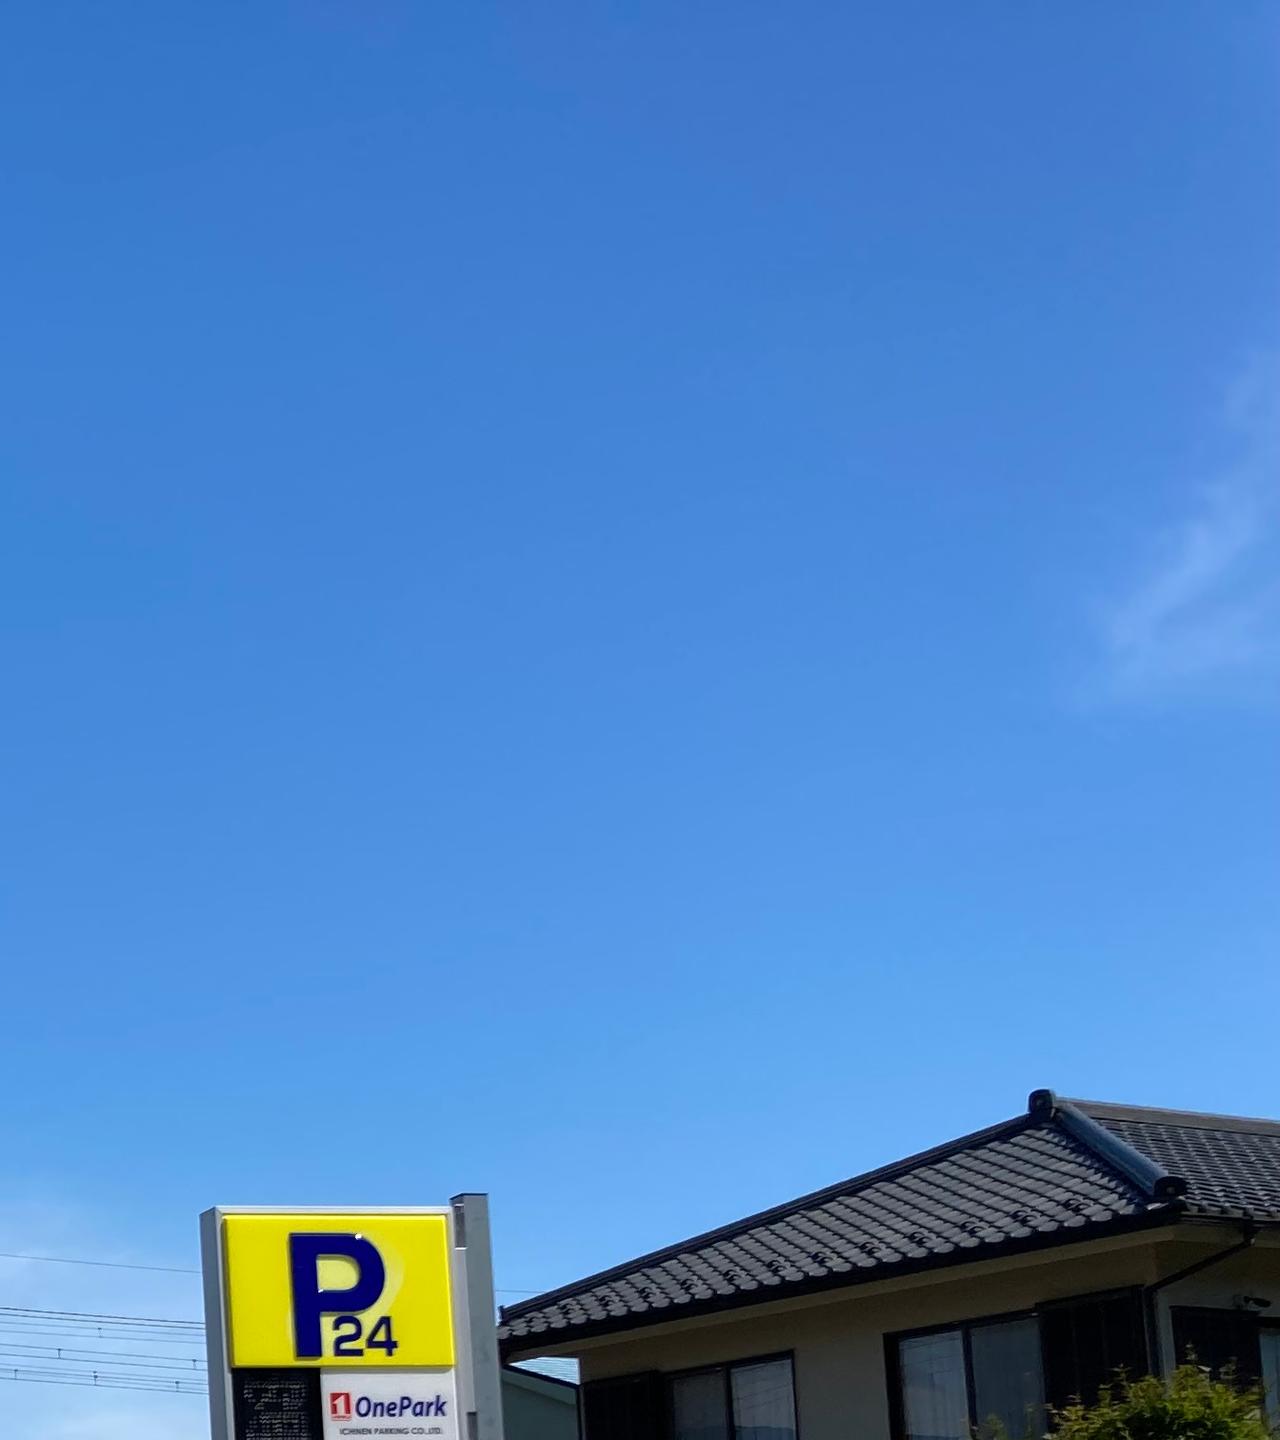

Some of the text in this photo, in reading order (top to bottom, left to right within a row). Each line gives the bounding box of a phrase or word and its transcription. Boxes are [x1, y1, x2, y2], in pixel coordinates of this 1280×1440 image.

[289, 1232, 386, 1358] P
[331, 1315, 399, 1357] 24
[355, 1394, 447, 1418] OnePark
[339, 1427, 373, 1435] ICHINEN
[374, 1427, 410, 1435] PARKING
